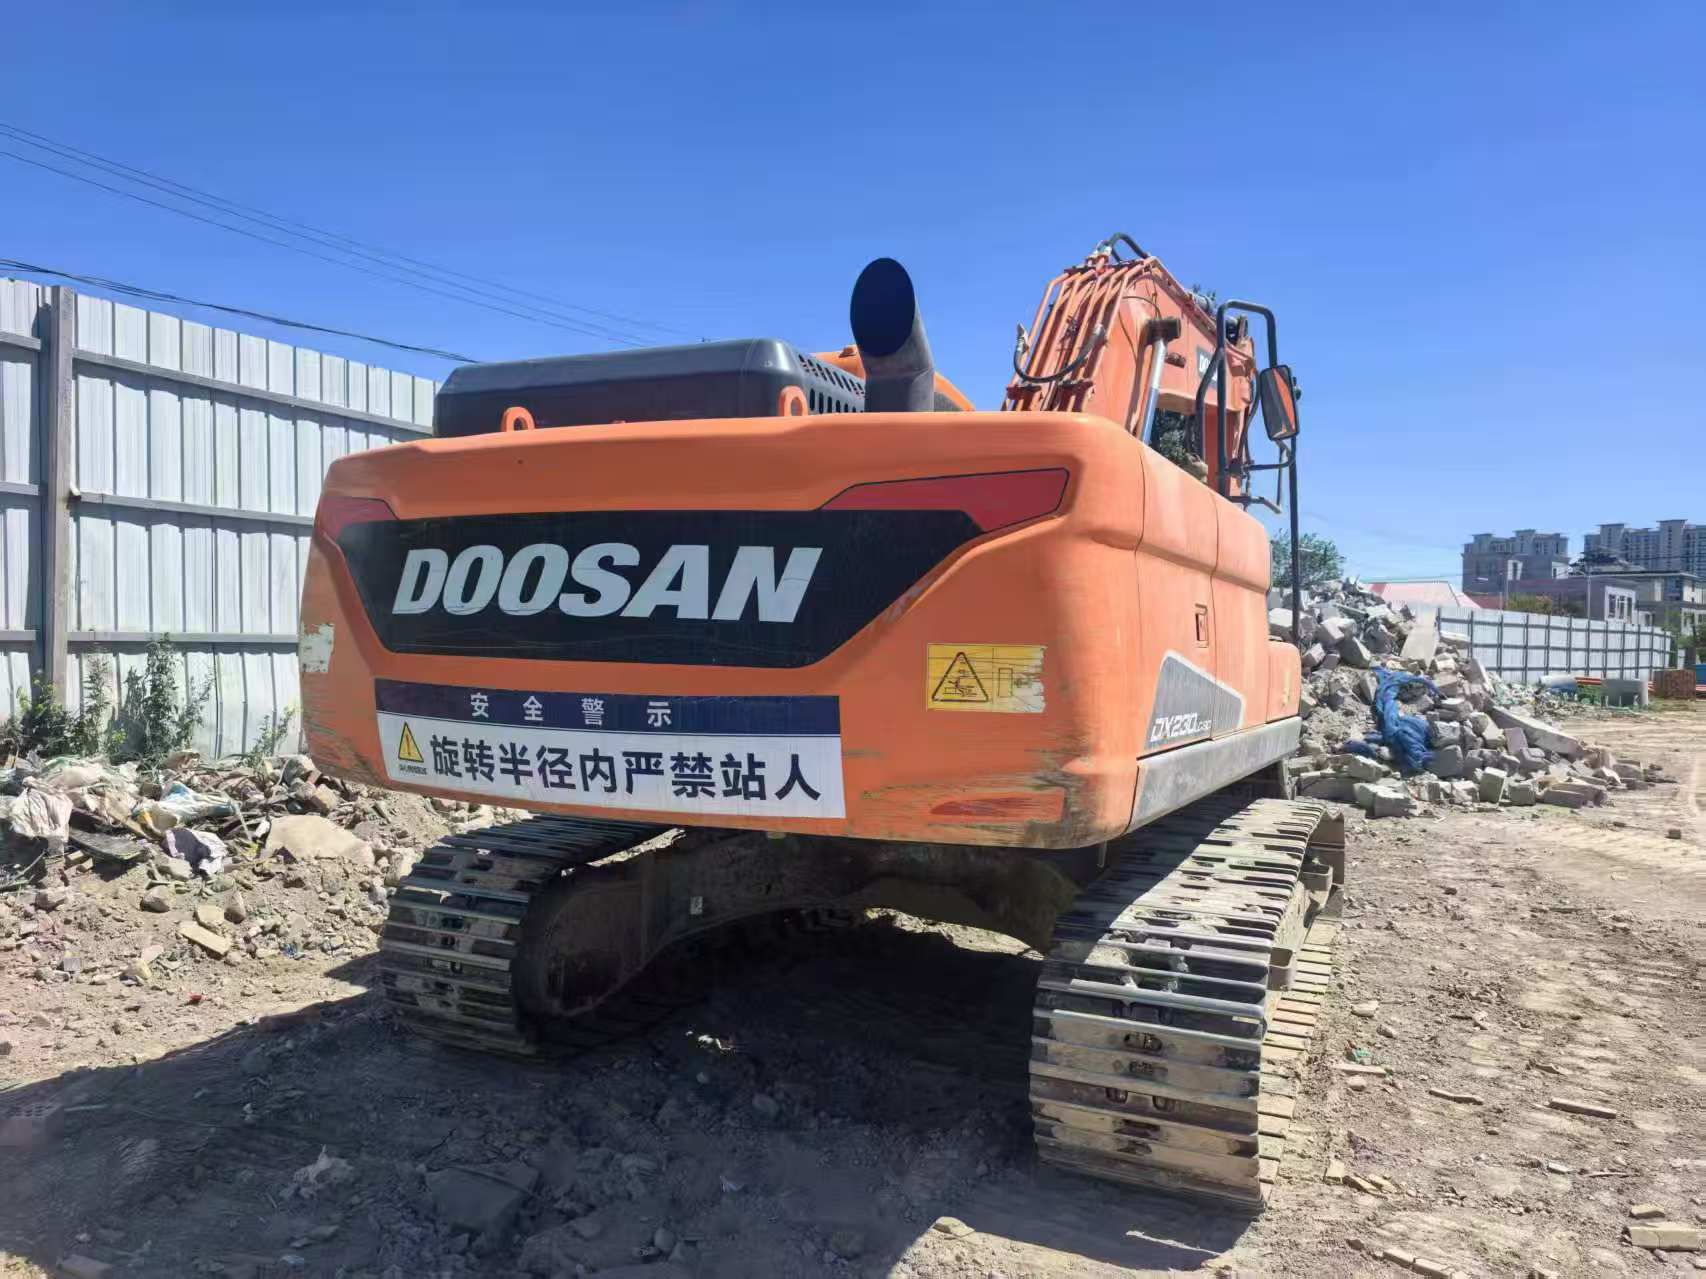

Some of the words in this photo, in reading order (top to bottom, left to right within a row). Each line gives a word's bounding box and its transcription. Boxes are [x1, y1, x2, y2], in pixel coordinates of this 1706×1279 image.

[392, 543, 823, 623] DOOSAN
[469, 692, 672, 727] 安全警示
[430, 734, 821, 801] 旋转半径内严禁站人
